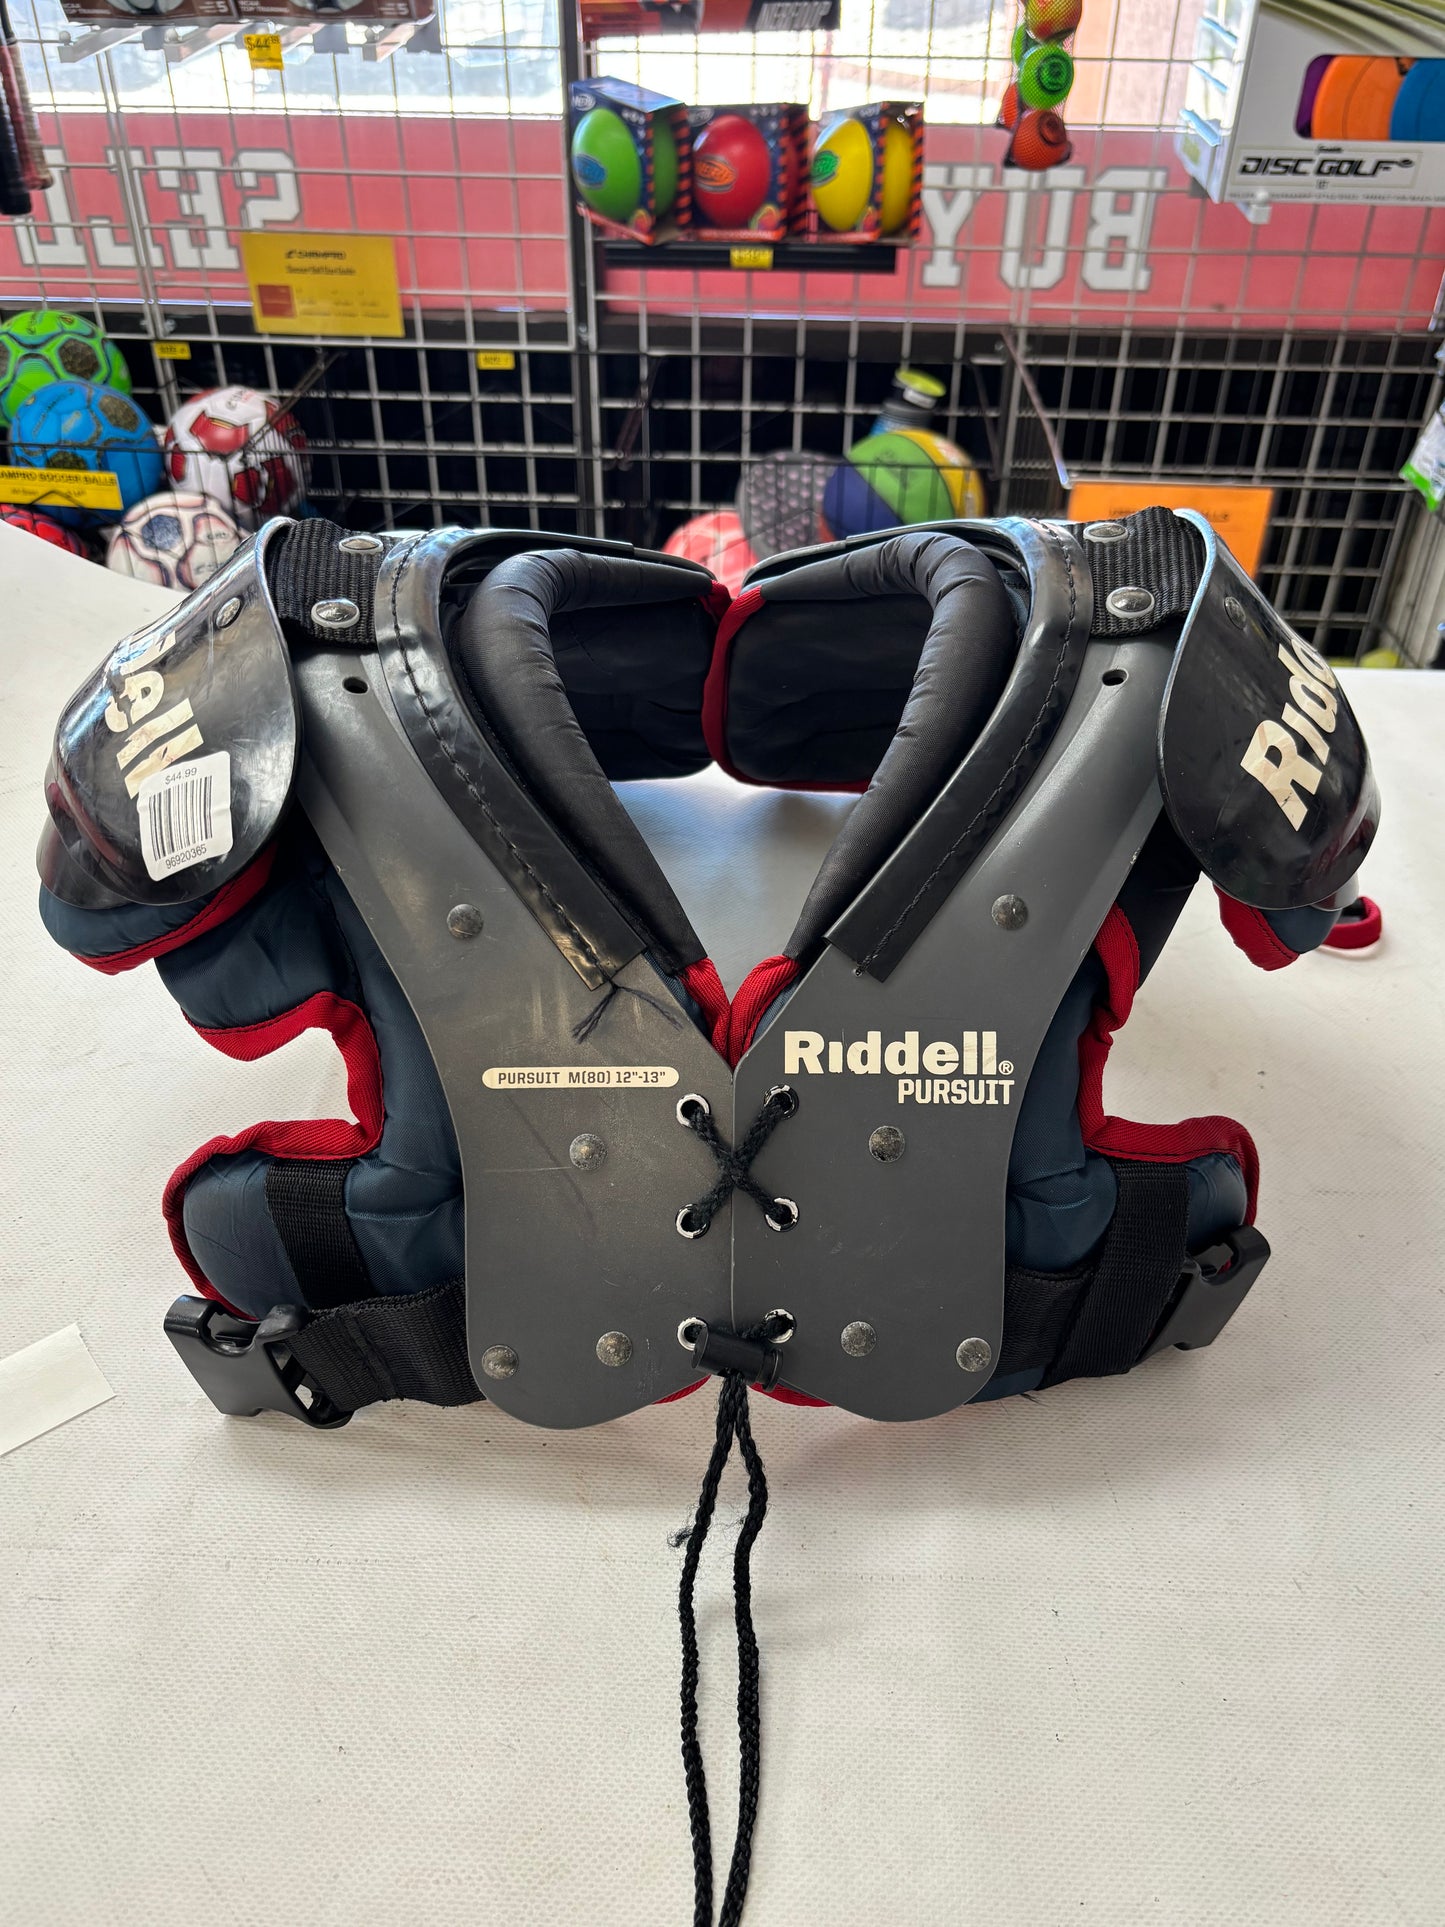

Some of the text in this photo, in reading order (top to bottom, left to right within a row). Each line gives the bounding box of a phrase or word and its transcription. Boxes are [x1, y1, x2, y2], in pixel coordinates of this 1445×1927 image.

[216, 1, 229, 13] 5
[398, 2, 409, 15] 5
[1240, 157, 1397, 177] DISC GOLF
[164, 766, 198, 786] $44.99
[165, 843, 208, 871] 96920365
[498, 1070, 666, 1085] PURSUIT M(80) 12"-13"
[898, 1079, 1015, 1105] PURSUIT
